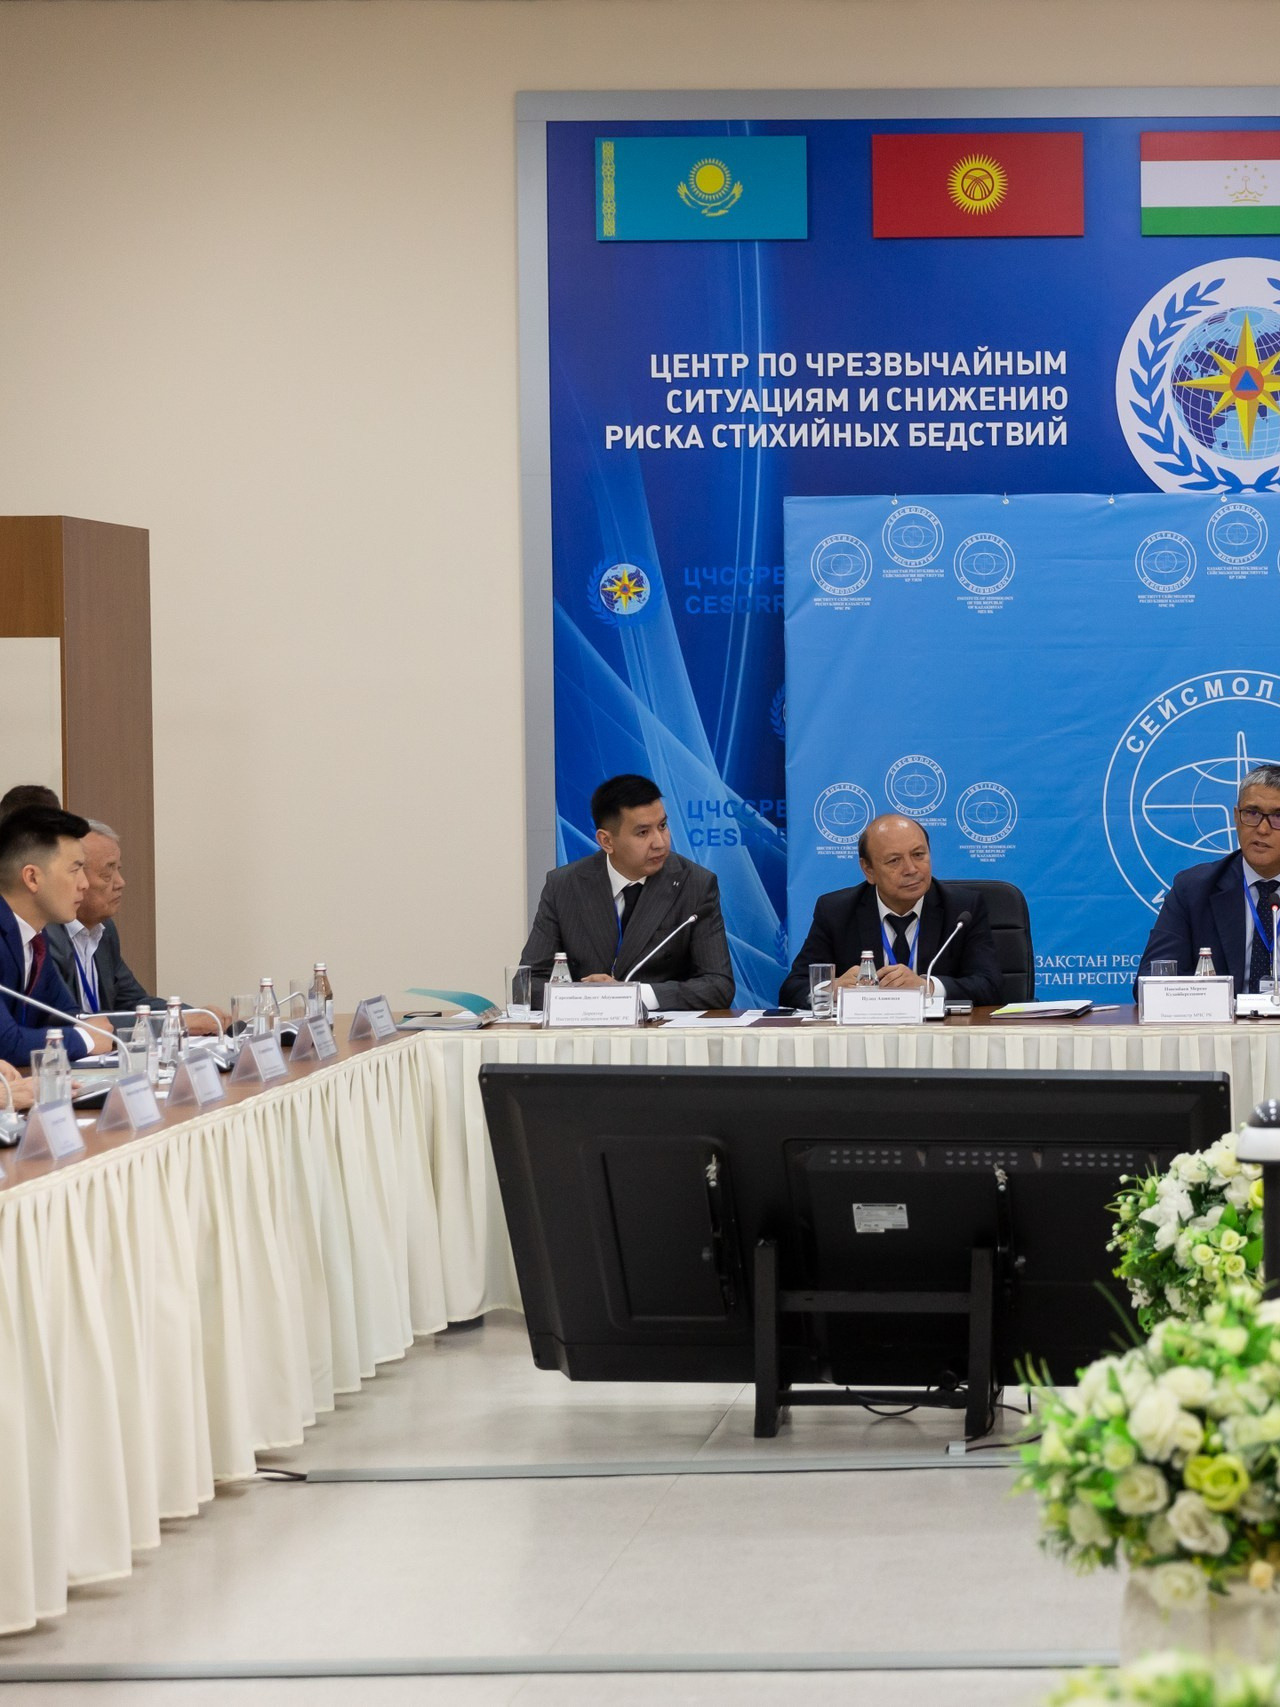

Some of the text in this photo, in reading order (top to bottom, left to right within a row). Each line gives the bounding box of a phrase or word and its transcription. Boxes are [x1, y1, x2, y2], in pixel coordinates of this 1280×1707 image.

[650, 346, 1067, 382] ЦЕНТР ПО ЧРЕЗВЫЧАЙНЫМ
[666, 386, 1069, 417] СИТУАЦИЯМ И СНИЖЕНИЮ
[605, 416, 1068, 452] РИСКА СТИХИЙНЫХ БЕДСТВИЙ
[1035, 955, 1107, 969] ЗАҚСТАН
